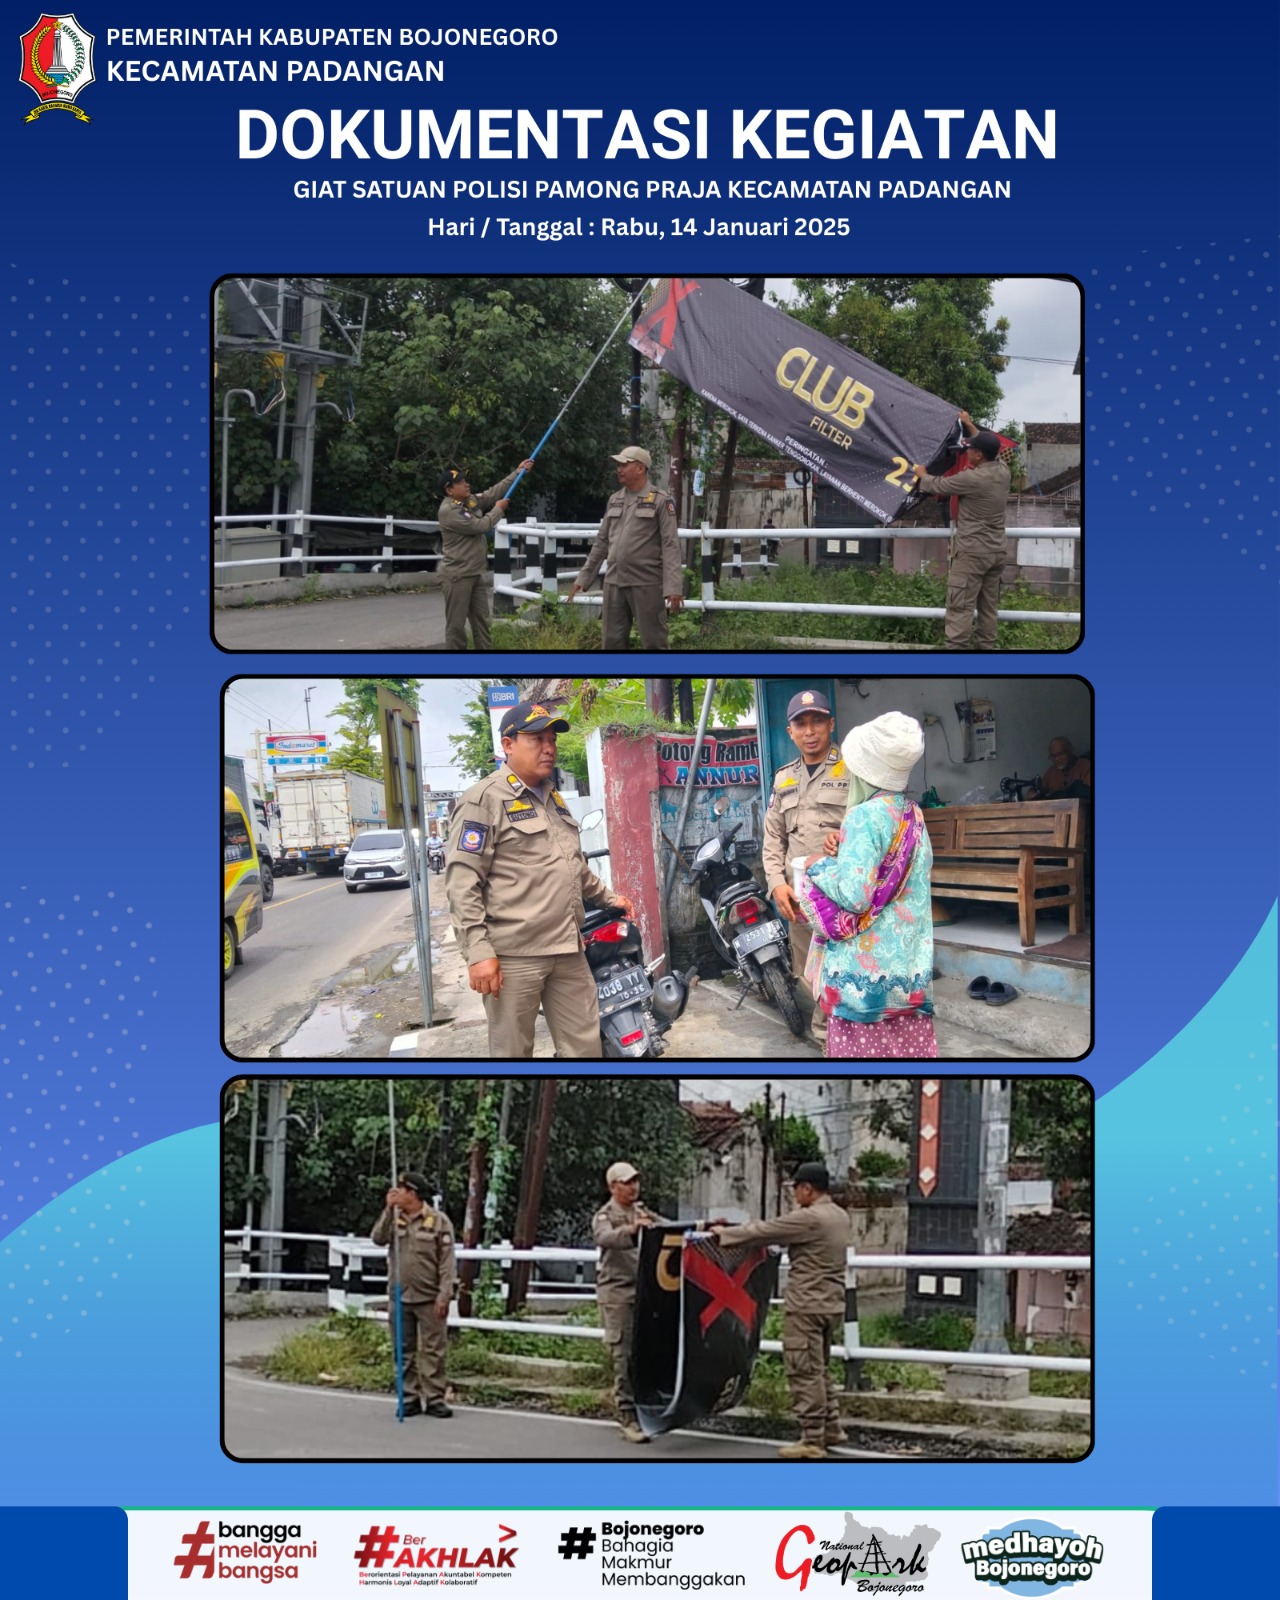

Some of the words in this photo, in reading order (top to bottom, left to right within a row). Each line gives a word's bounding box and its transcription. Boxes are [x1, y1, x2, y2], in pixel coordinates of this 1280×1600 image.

[775, 346, 876, 431] CLUB
[810, 415, 853, 450] FILTER
[784, 435, 825, 466] PERINGATAN
[501, 692, 514, 701] BRI
[675, 764, 760, 787] ANNUR
[744, 927, 766, 942] 2531
[625, 971, 640, 986] YY
